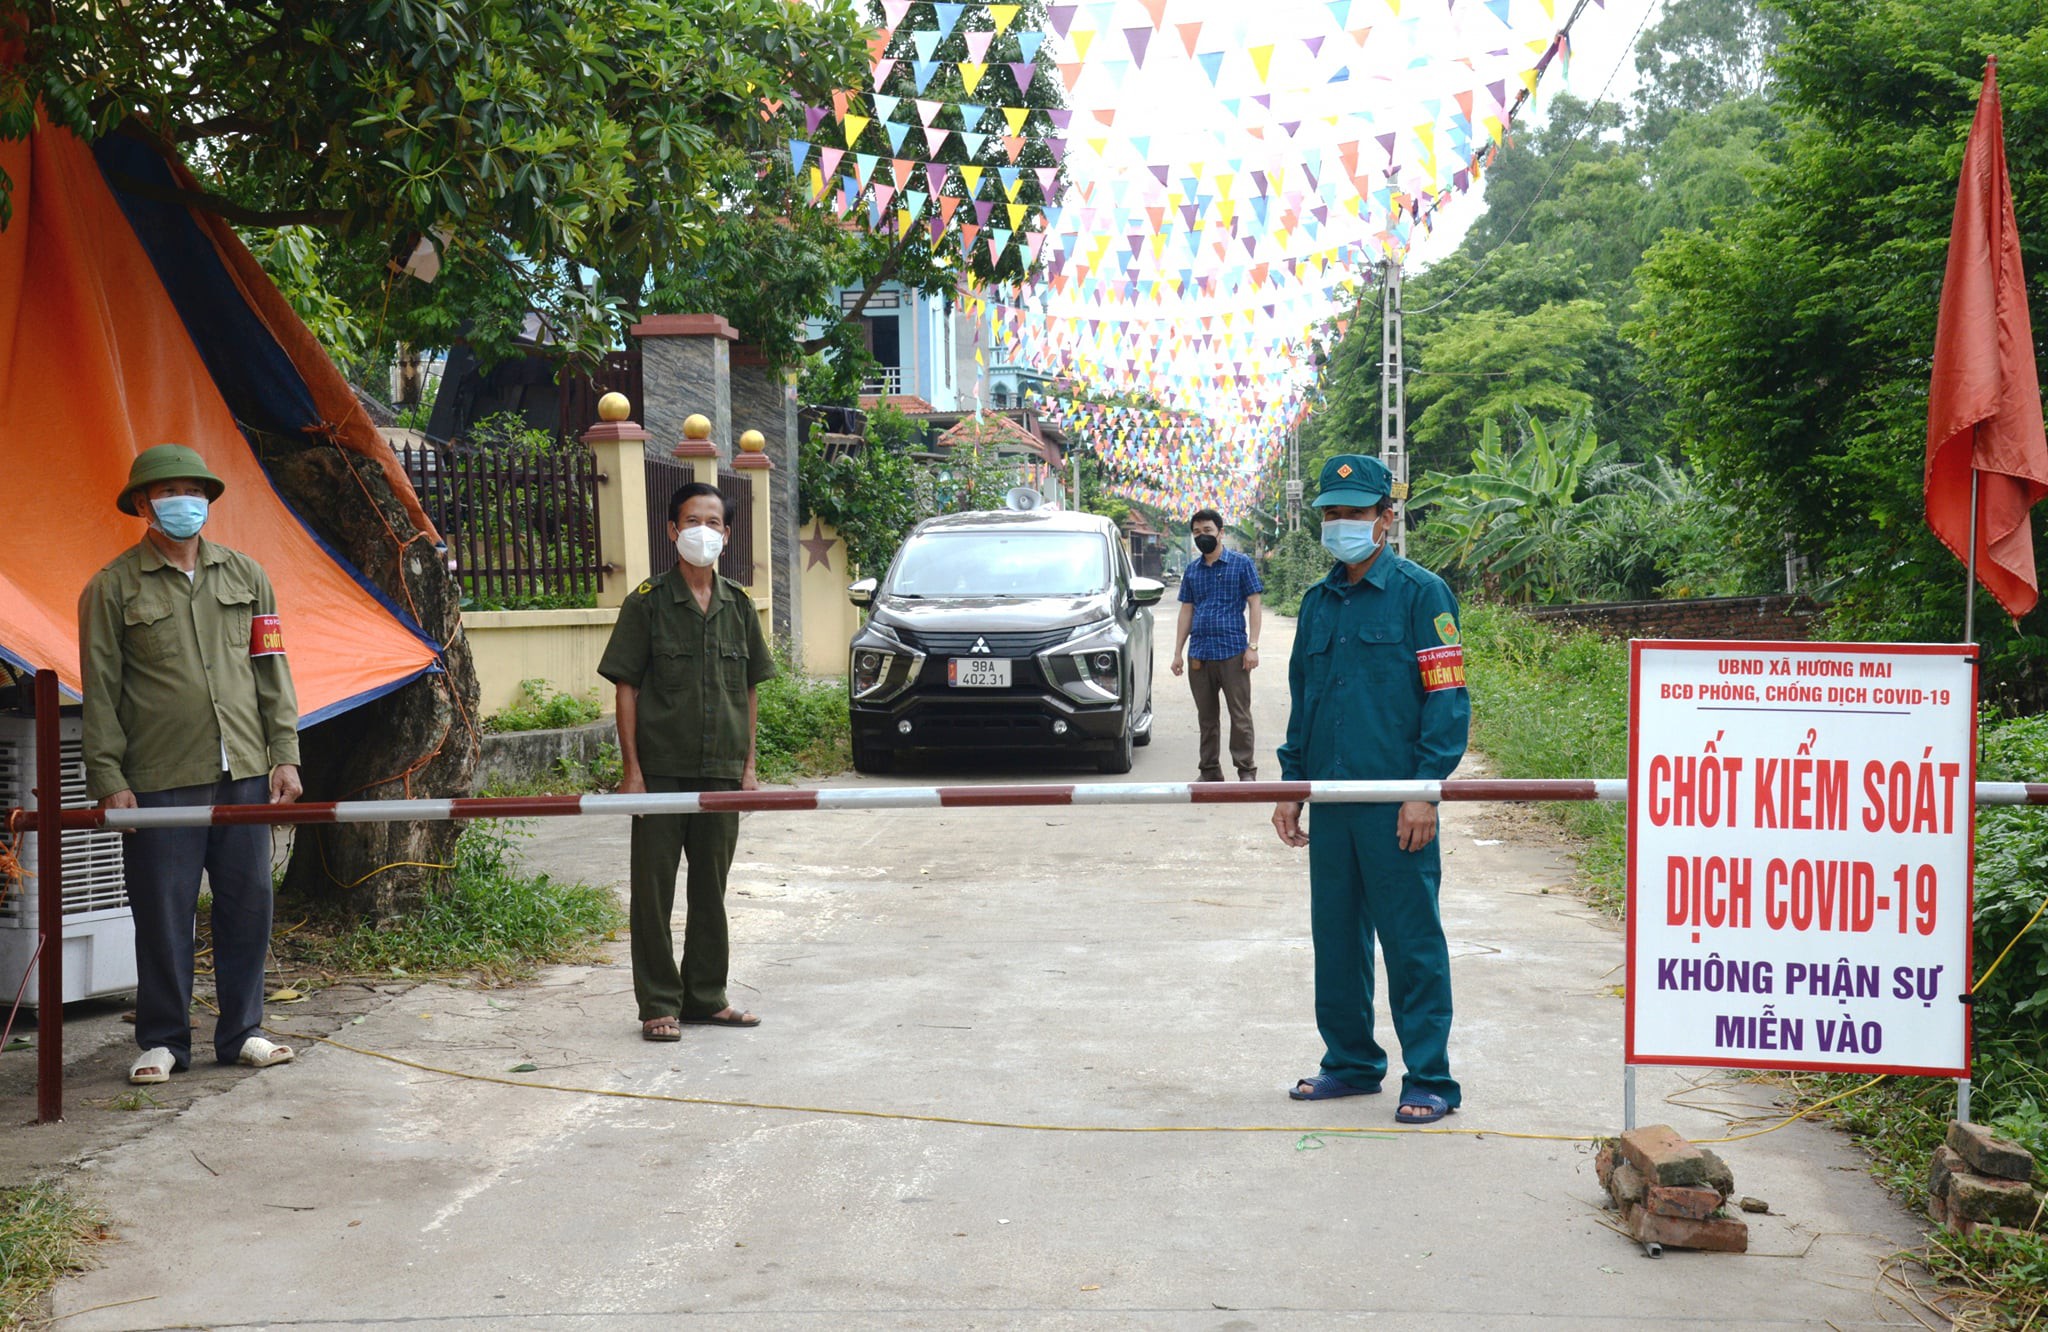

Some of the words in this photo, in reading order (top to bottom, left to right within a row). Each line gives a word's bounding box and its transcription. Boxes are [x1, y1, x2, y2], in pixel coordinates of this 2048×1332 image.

[962, 673, 1004, 685] 402.31
[971, 660, 995, 673] 98A
[1428, 662, 1453, 687] KIỂM
[1717, 658, 1765, 676] UBND
[1768, 656, 1792, 676] XÃ
[1796, 659, 1854, 678] HƯƠNG
[1859, 661, 1893, 678] MAI
[1660, 683, 1693, 700] BCĐ
[1699, 681, 1760, 702] PHÒNG,
[1766, 681, 1823, 703] CHỐNG
[1828, 686, 1867, 707] DỊCH
[1872, 688, 1950, 706] COVID-19
[1648, 730, 1742, 828] CHỐT
[1754, 728, 1849, 831] KIỂM
[1862, 747, 1960, 834] SOÁT
[1666, 855, 1752, 943] DỊCH
[1766, 858, 1937, 936] COVID-19
[1657, 952, 1773, 995] KHÔNG
[1785, 957, 1880, 1005] PHẬN
[1892, 964, 1944, 1008] SỰ
[1715, 1004, 1804, 1051] MIỄN
[1815, 1013, 1883, 1054] VÀO
